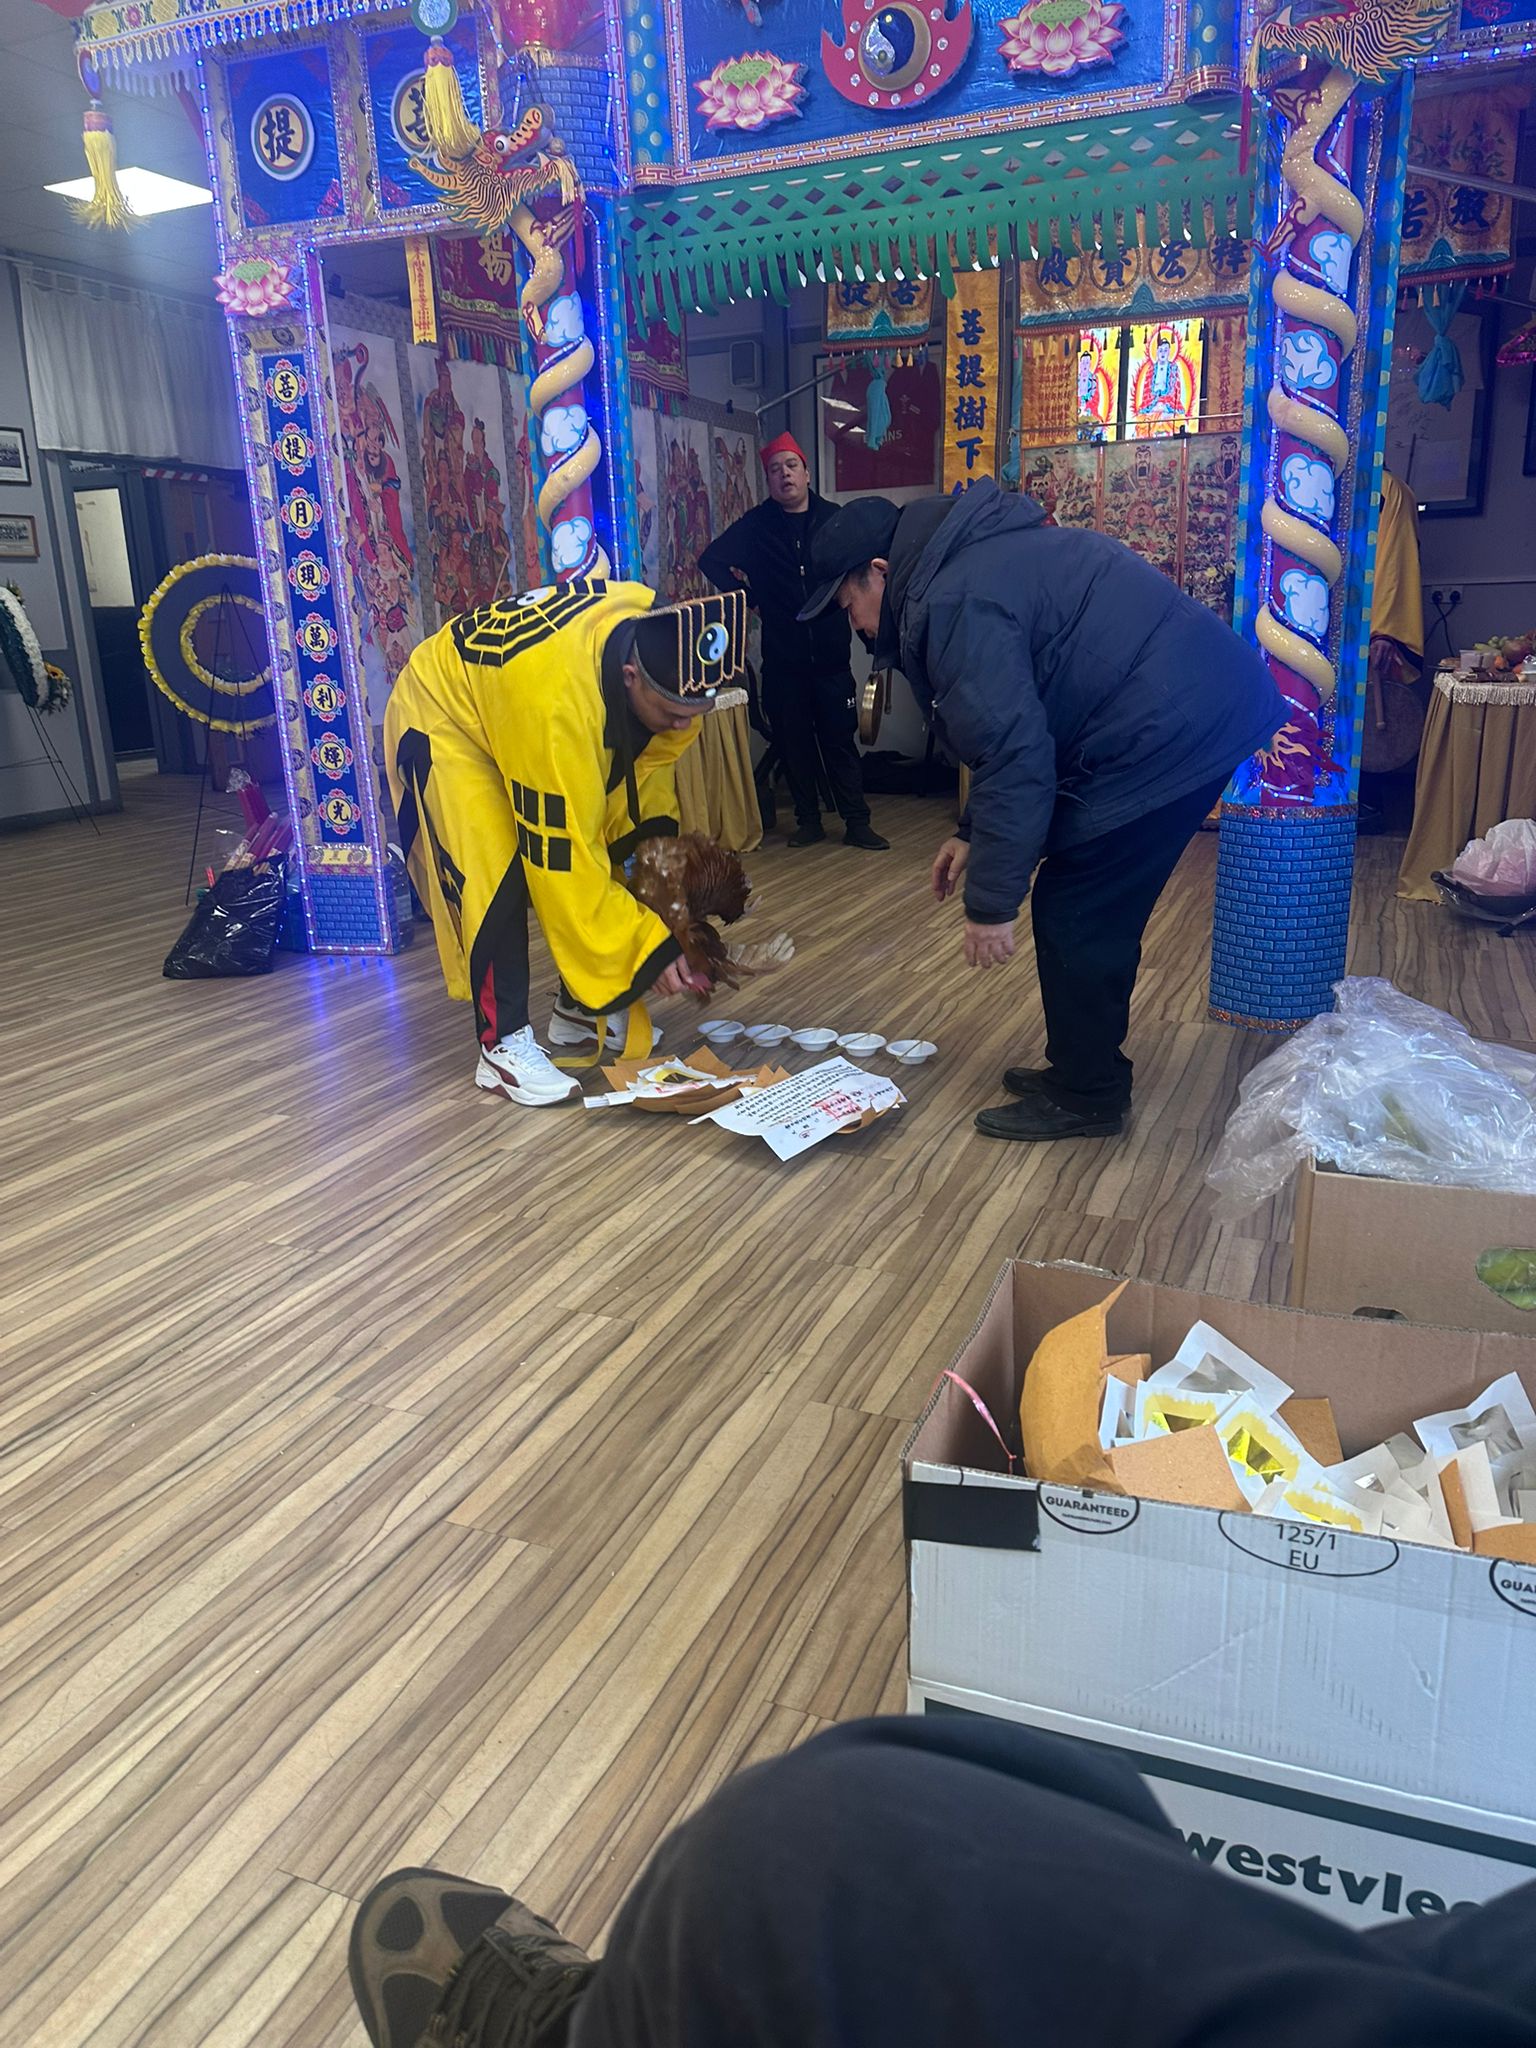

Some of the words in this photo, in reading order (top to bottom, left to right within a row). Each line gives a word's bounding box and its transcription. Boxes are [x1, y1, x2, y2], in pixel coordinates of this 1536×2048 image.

[262, 107, 298, 163] 提
[1045, 1496, 1130, 1518] GUARANTEED
[1277, 1523, 1337, 1550] 125/1
[1289, 1549, 1319, 1570] EU
[1501, 1579, 1536, 1594] GUA
[1173, 1827, 1486, 1920] westvle
